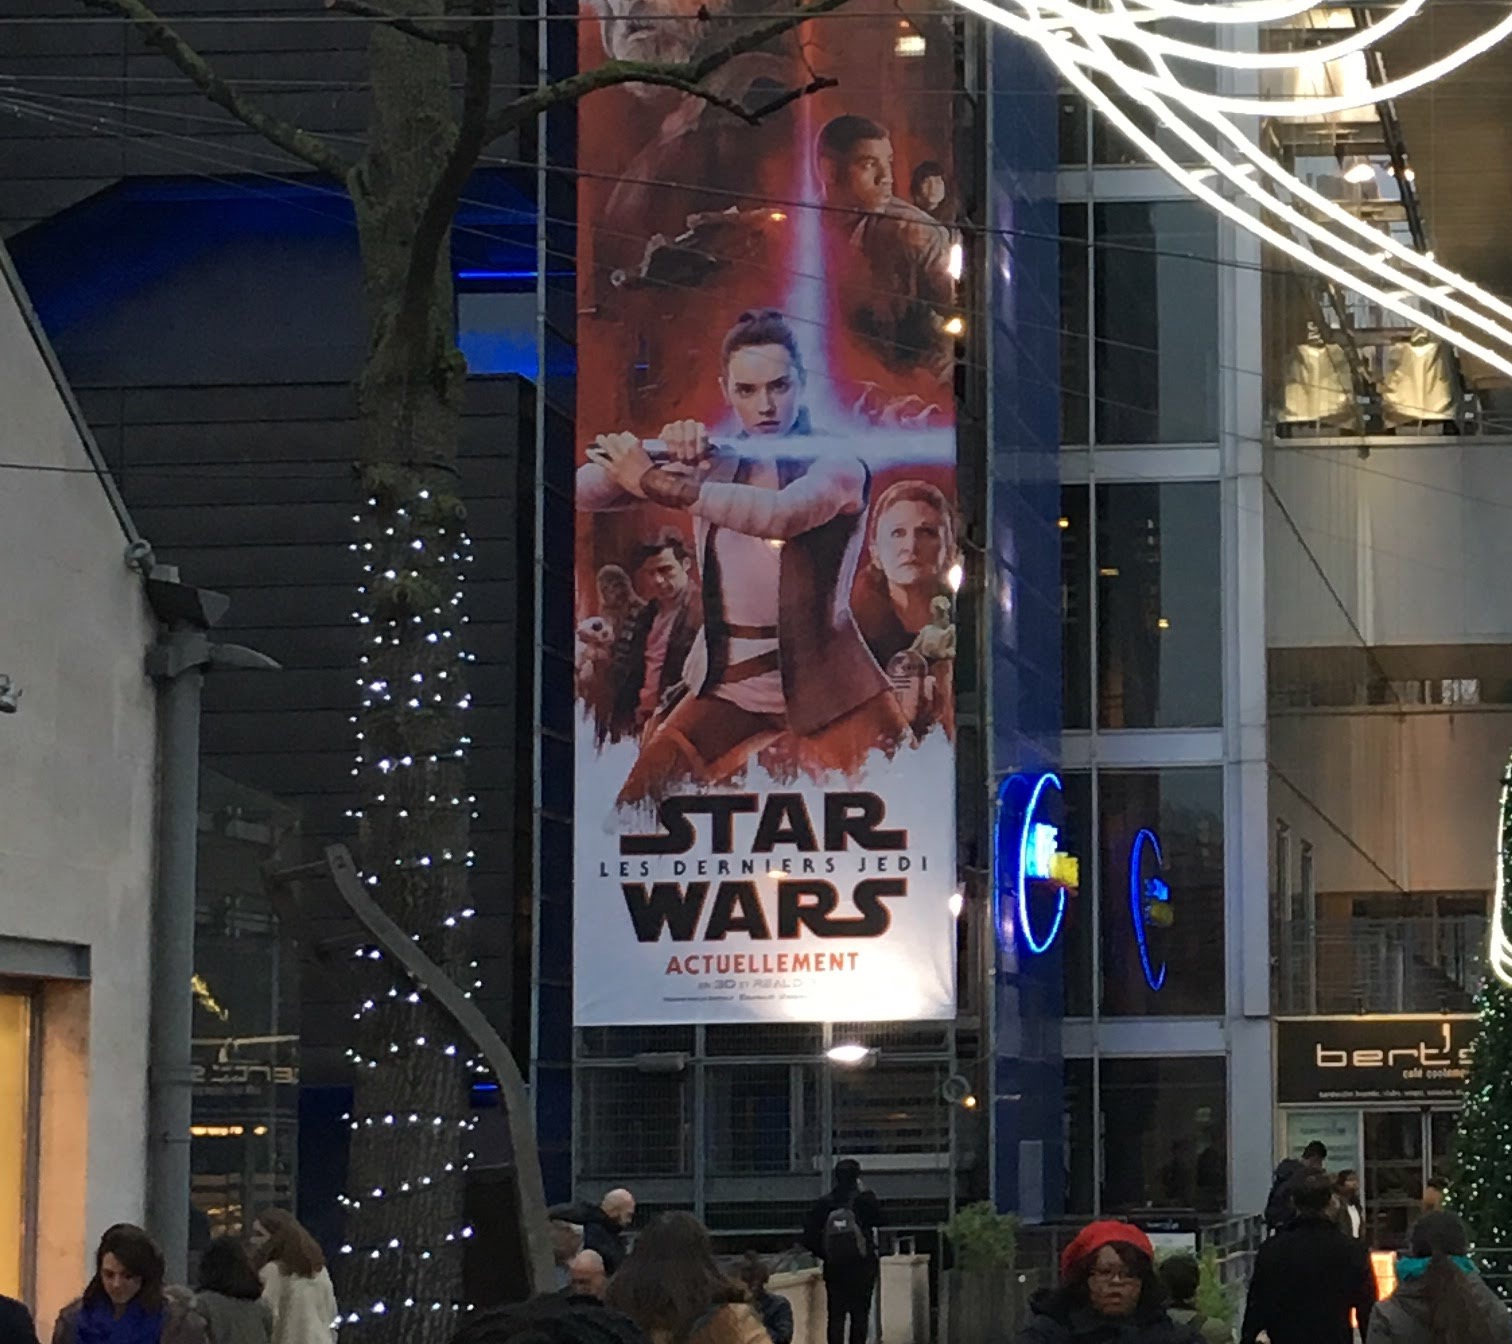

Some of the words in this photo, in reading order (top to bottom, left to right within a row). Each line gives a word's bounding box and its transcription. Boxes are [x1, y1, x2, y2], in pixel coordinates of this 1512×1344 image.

[620, 792, 907, 855] STAR
[600, 861, 649, 877] LES
[674, 858, 835, 875] DERNIERS
[858, 856, 928, 873] JEDI
[621, 877, 908, 942] WARS
[664, 952, 859, 975] ACTUELLEMENT
